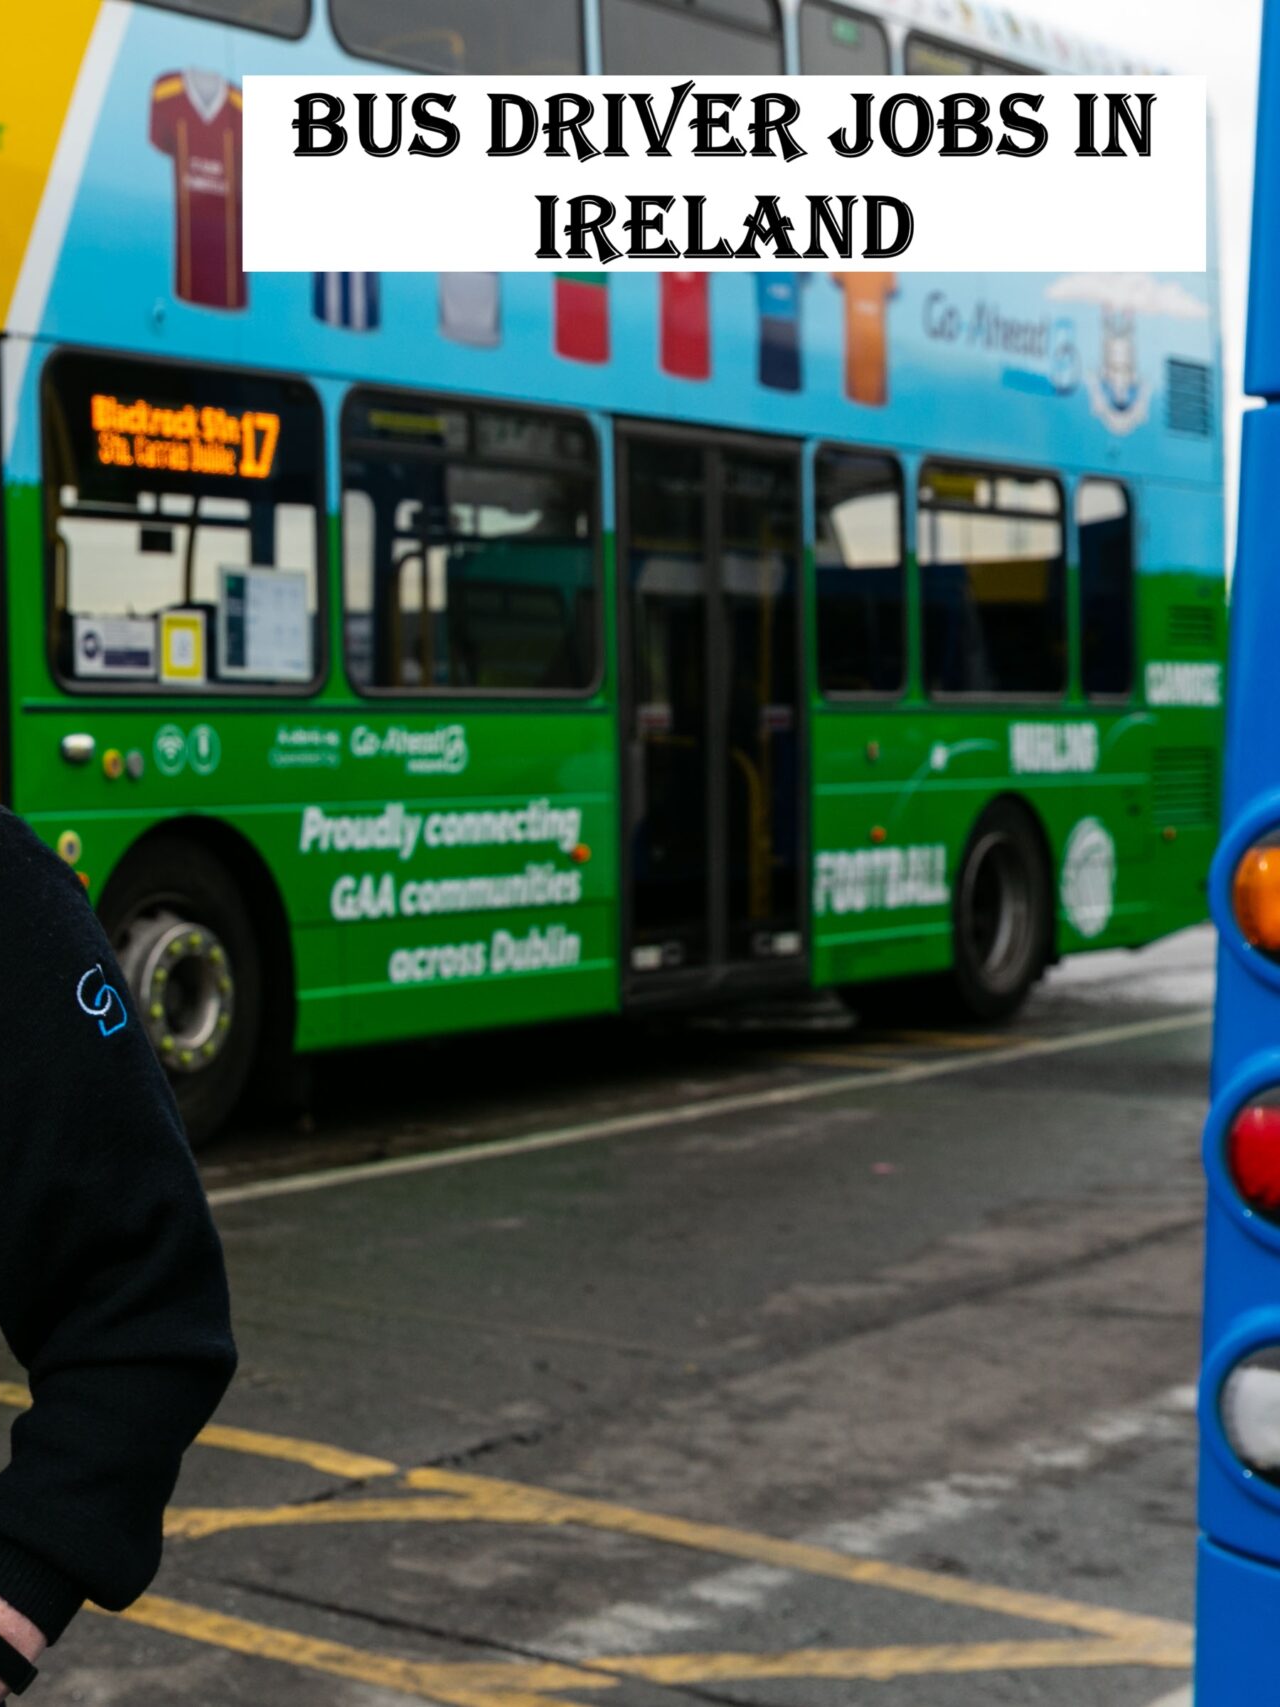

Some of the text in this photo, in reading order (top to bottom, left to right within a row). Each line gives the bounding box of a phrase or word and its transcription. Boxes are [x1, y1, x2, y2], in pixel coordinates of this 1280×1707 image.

[239, 411, 280, 478] 17
[300, 799, 581, 860] Proudly connecting
[331, 862, 581, 920] GAA communities
[814, 845, 950, 915] FOOTBALL
[389, 924, 581, 983] across Dublin
